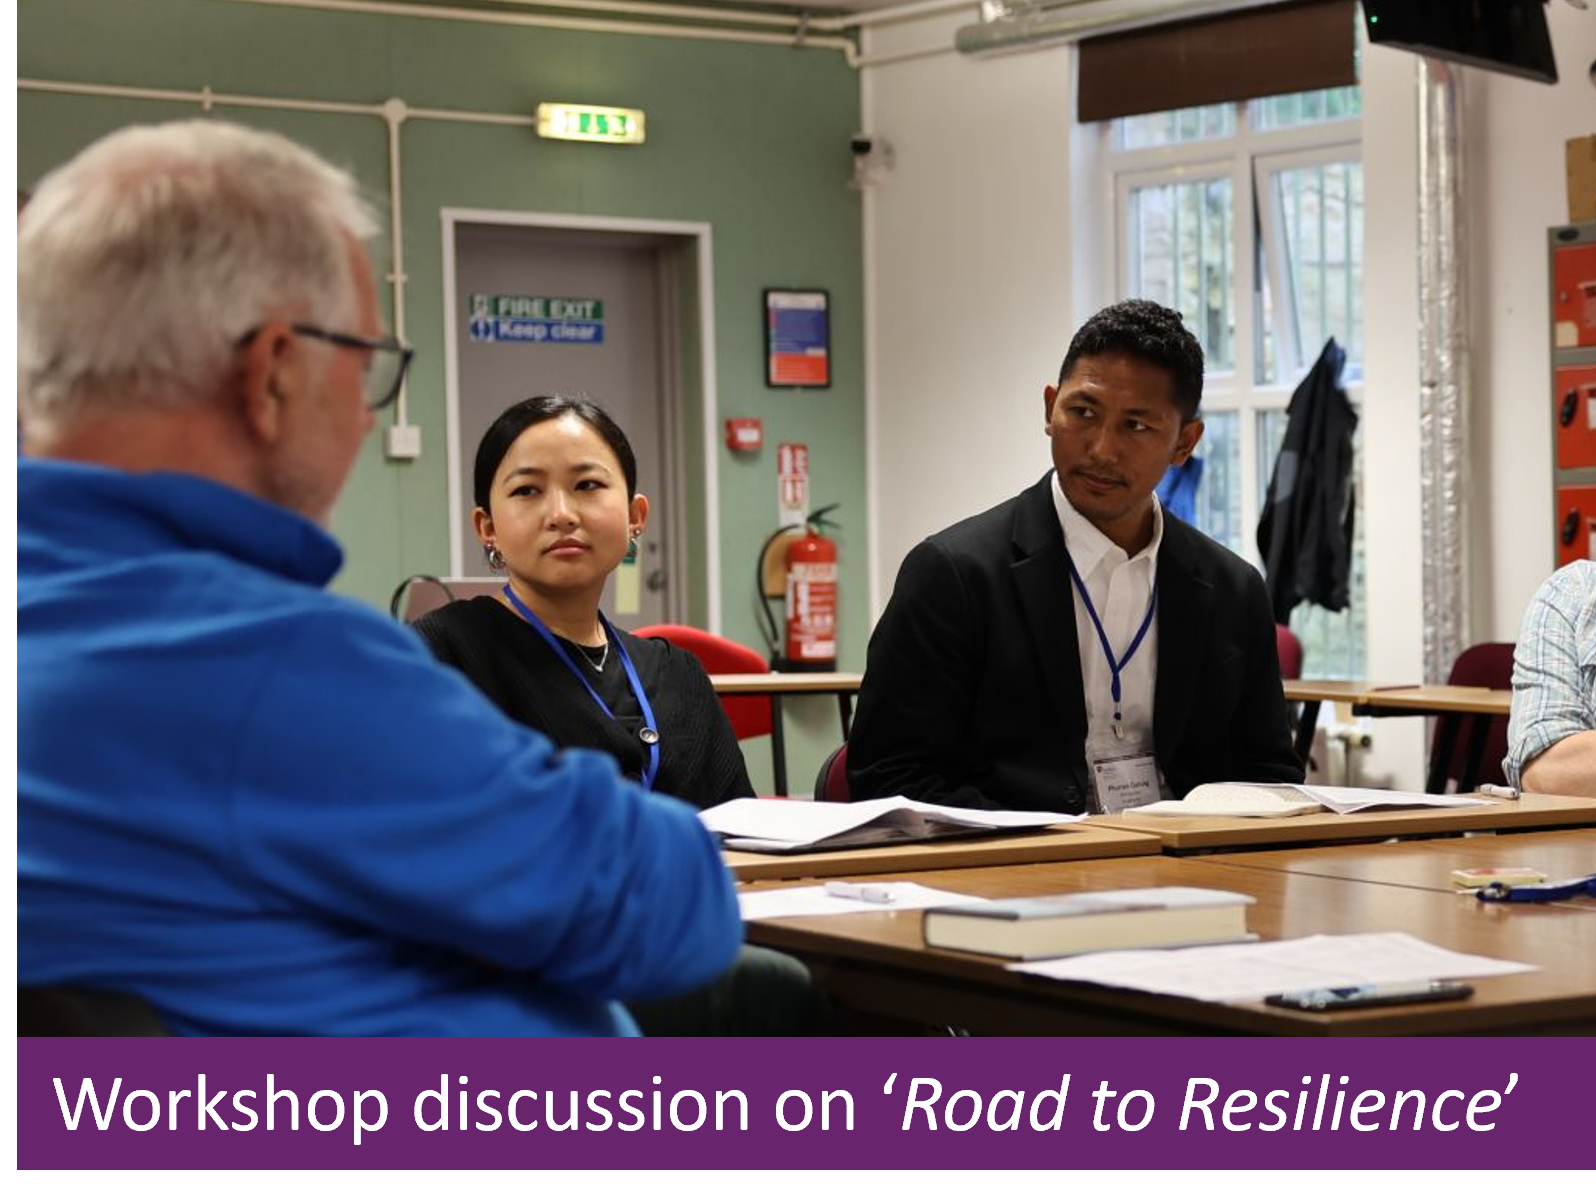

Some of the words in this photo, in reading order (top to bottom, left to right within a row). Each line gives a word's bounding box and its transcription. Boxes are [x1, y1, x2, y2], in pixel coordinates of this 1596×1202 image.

[498, 298, 544, 317] FIRE
[550, 300, 595, 318] EXIT
[499, 320, 547, 342] Keep
[551, 321, 595, 340] clear
